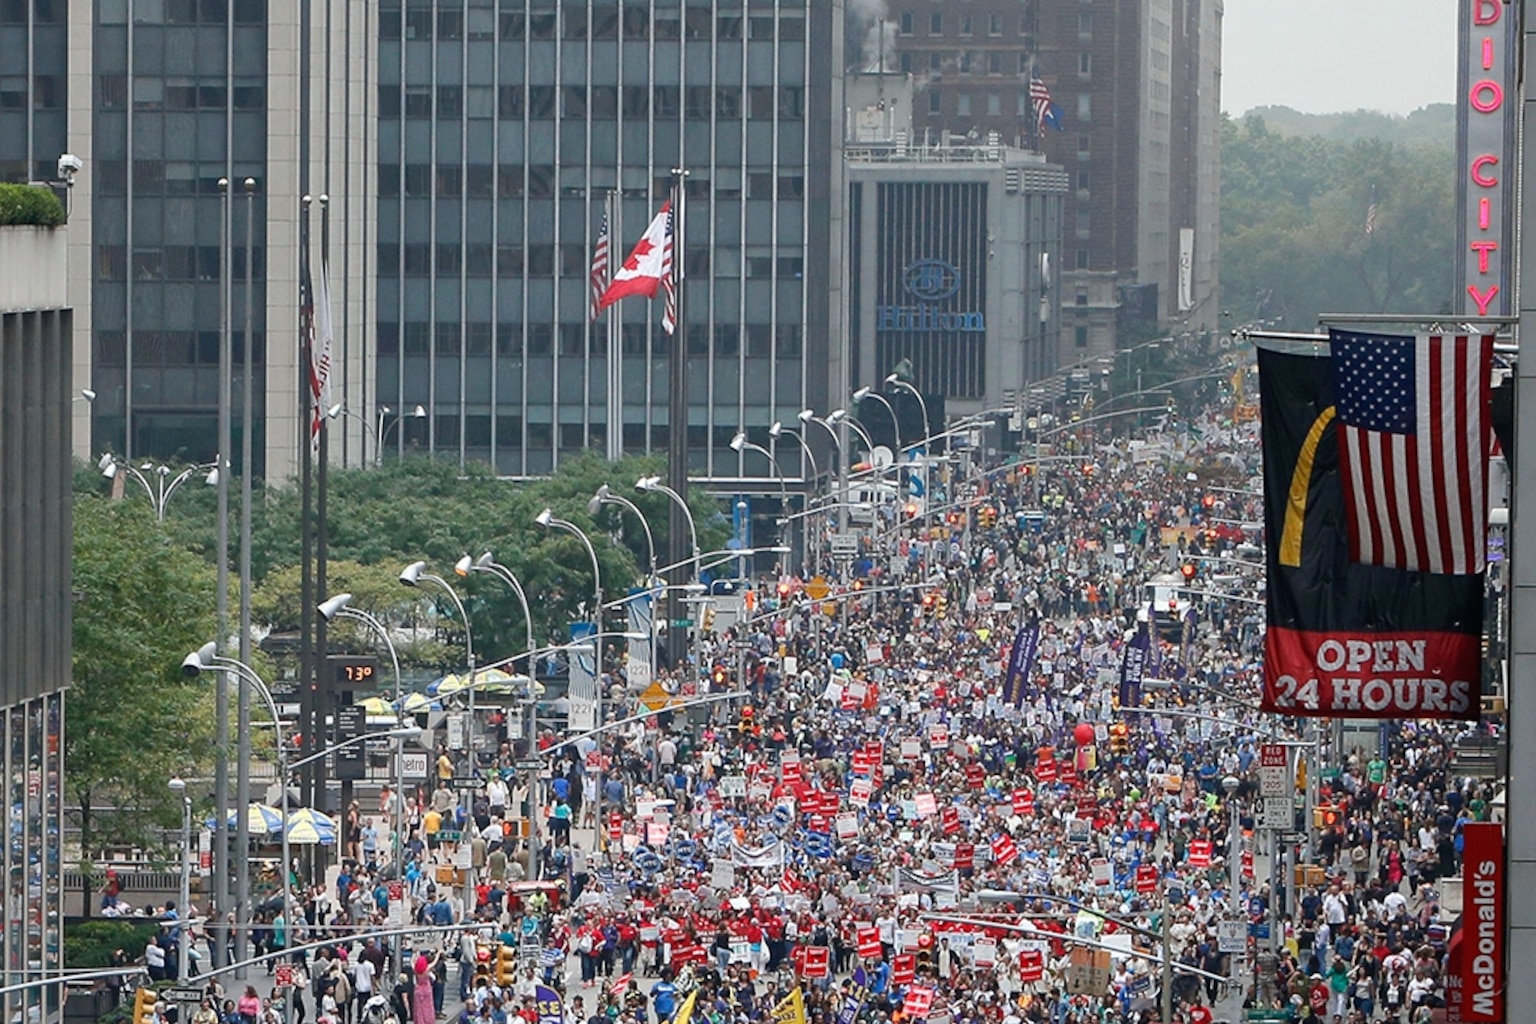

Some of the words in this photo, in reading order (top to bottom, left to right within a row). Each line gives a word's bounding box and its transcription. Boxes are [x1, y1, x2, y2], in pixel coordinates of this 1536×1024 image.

[1467, 156, 1500, 317] CITY
[877, 305, 985, 333] Hilton
[1316, 639, 1426, 673] OPEN
[1275, 675, 1319, 710] 24
[1332, 676, 1470, 714] HOURS
[1472, 861, 1496, 1016] McDonald's
